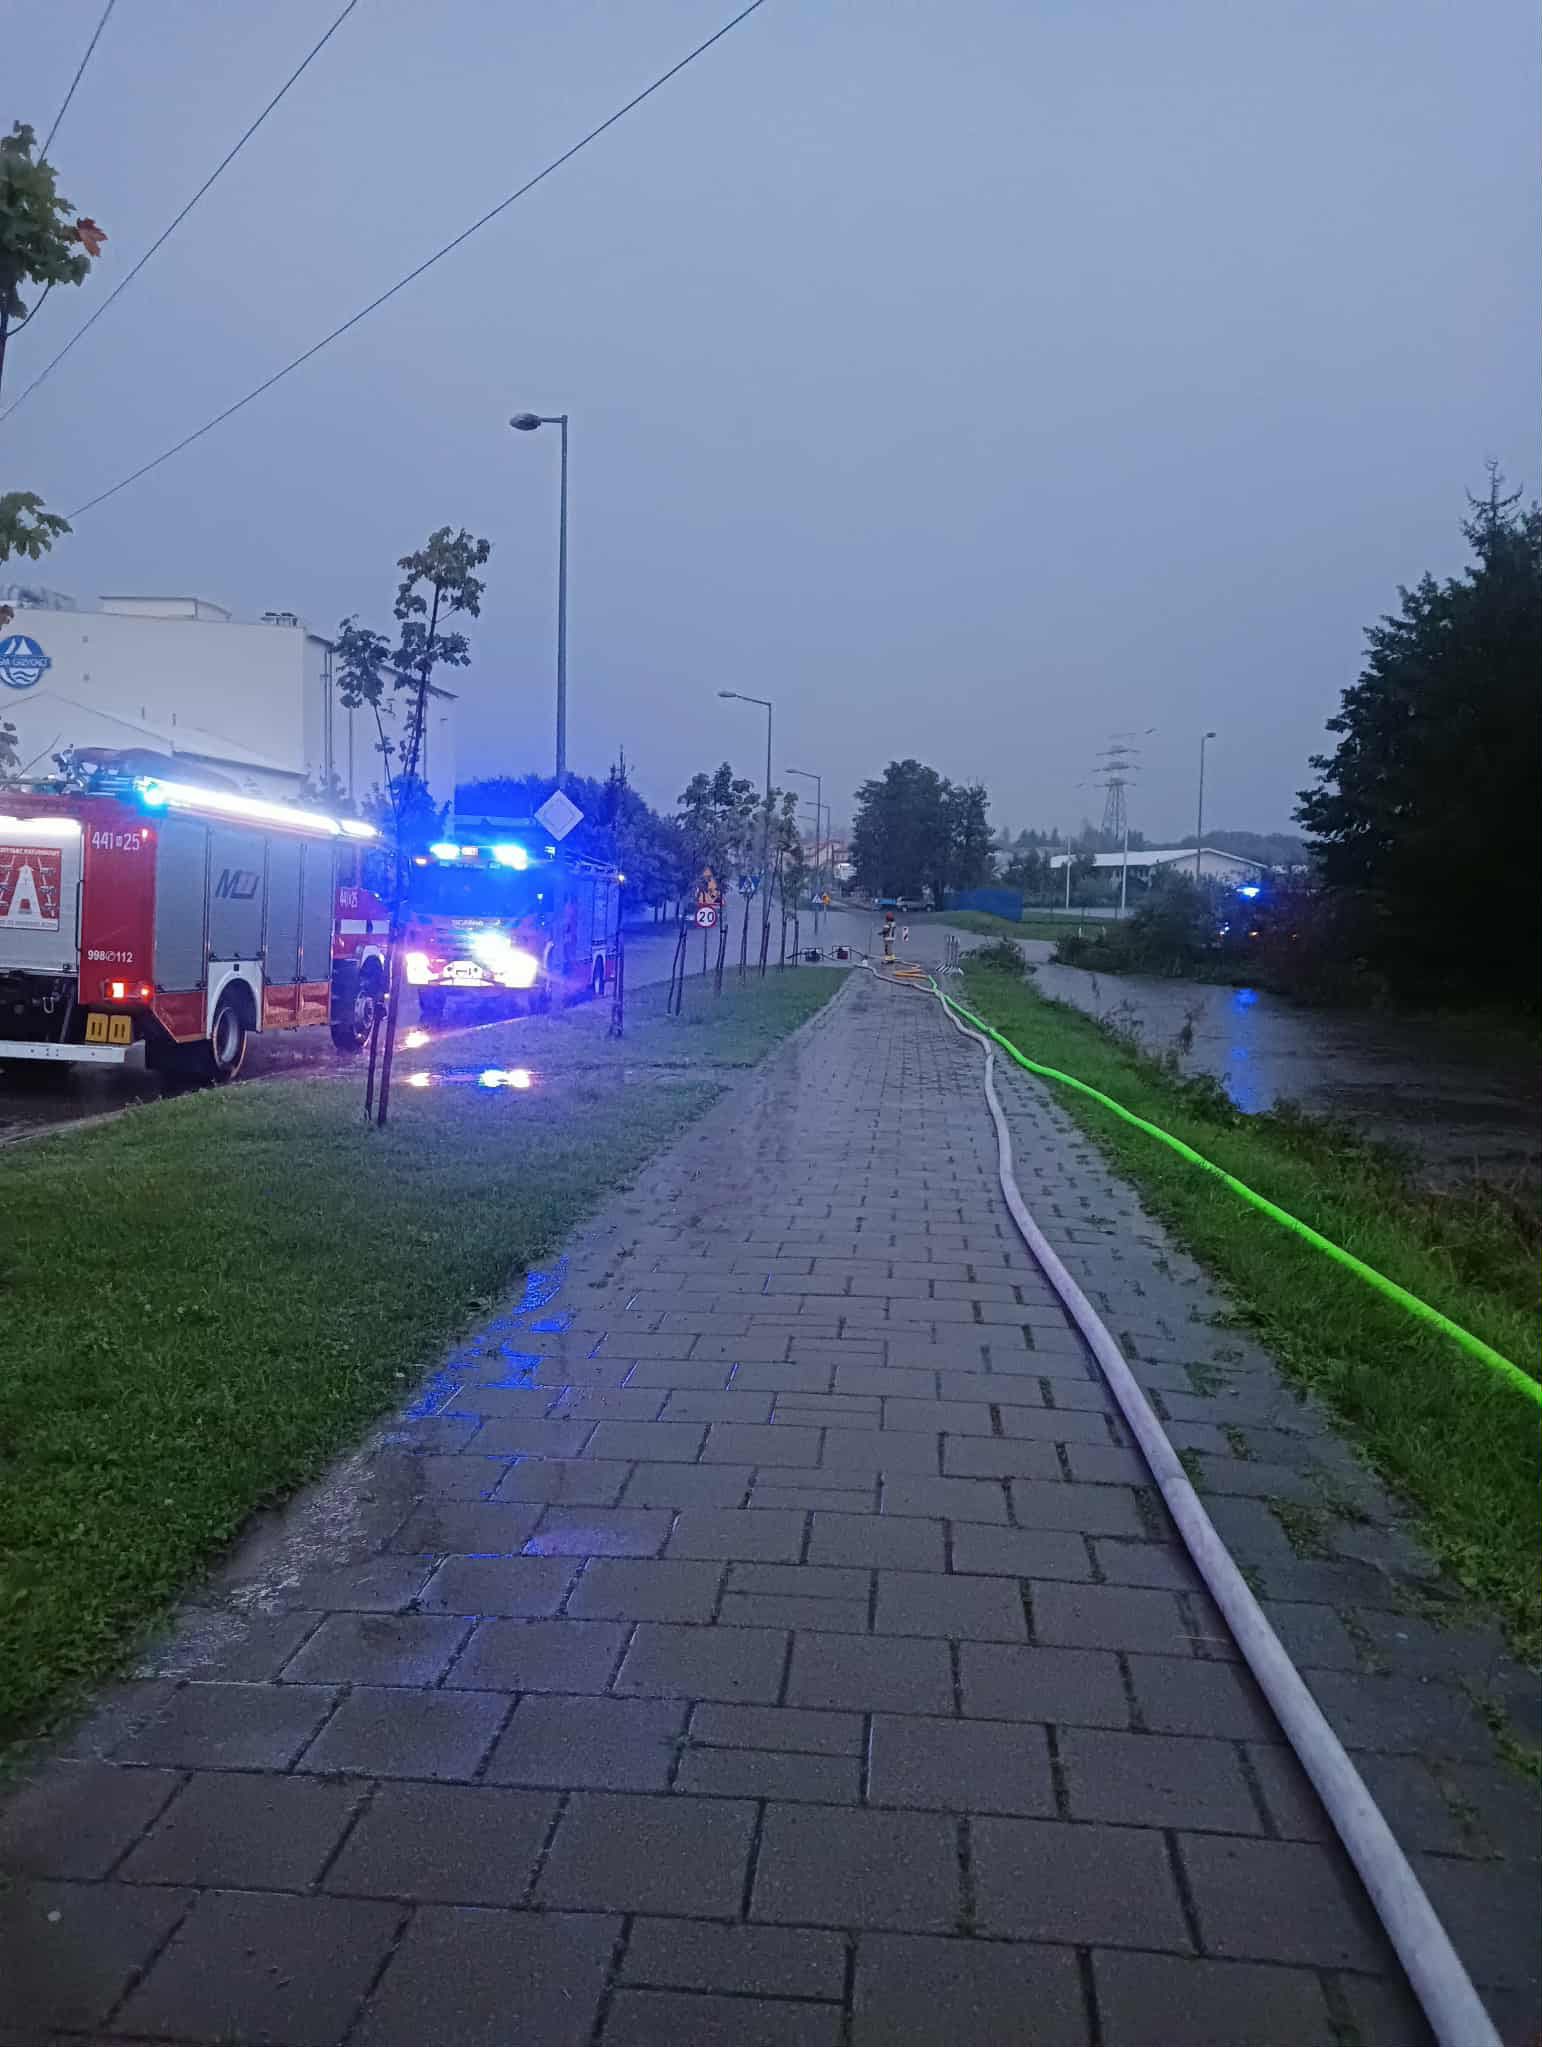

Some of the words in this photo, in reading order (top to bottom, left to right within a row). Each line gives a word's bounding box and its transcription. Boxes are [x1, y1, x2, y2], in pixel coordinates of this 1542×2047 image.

[699, 911, 715, 923] 20
[87, 949, 106, 961] 998
[116, 951, 133, 963] 112
